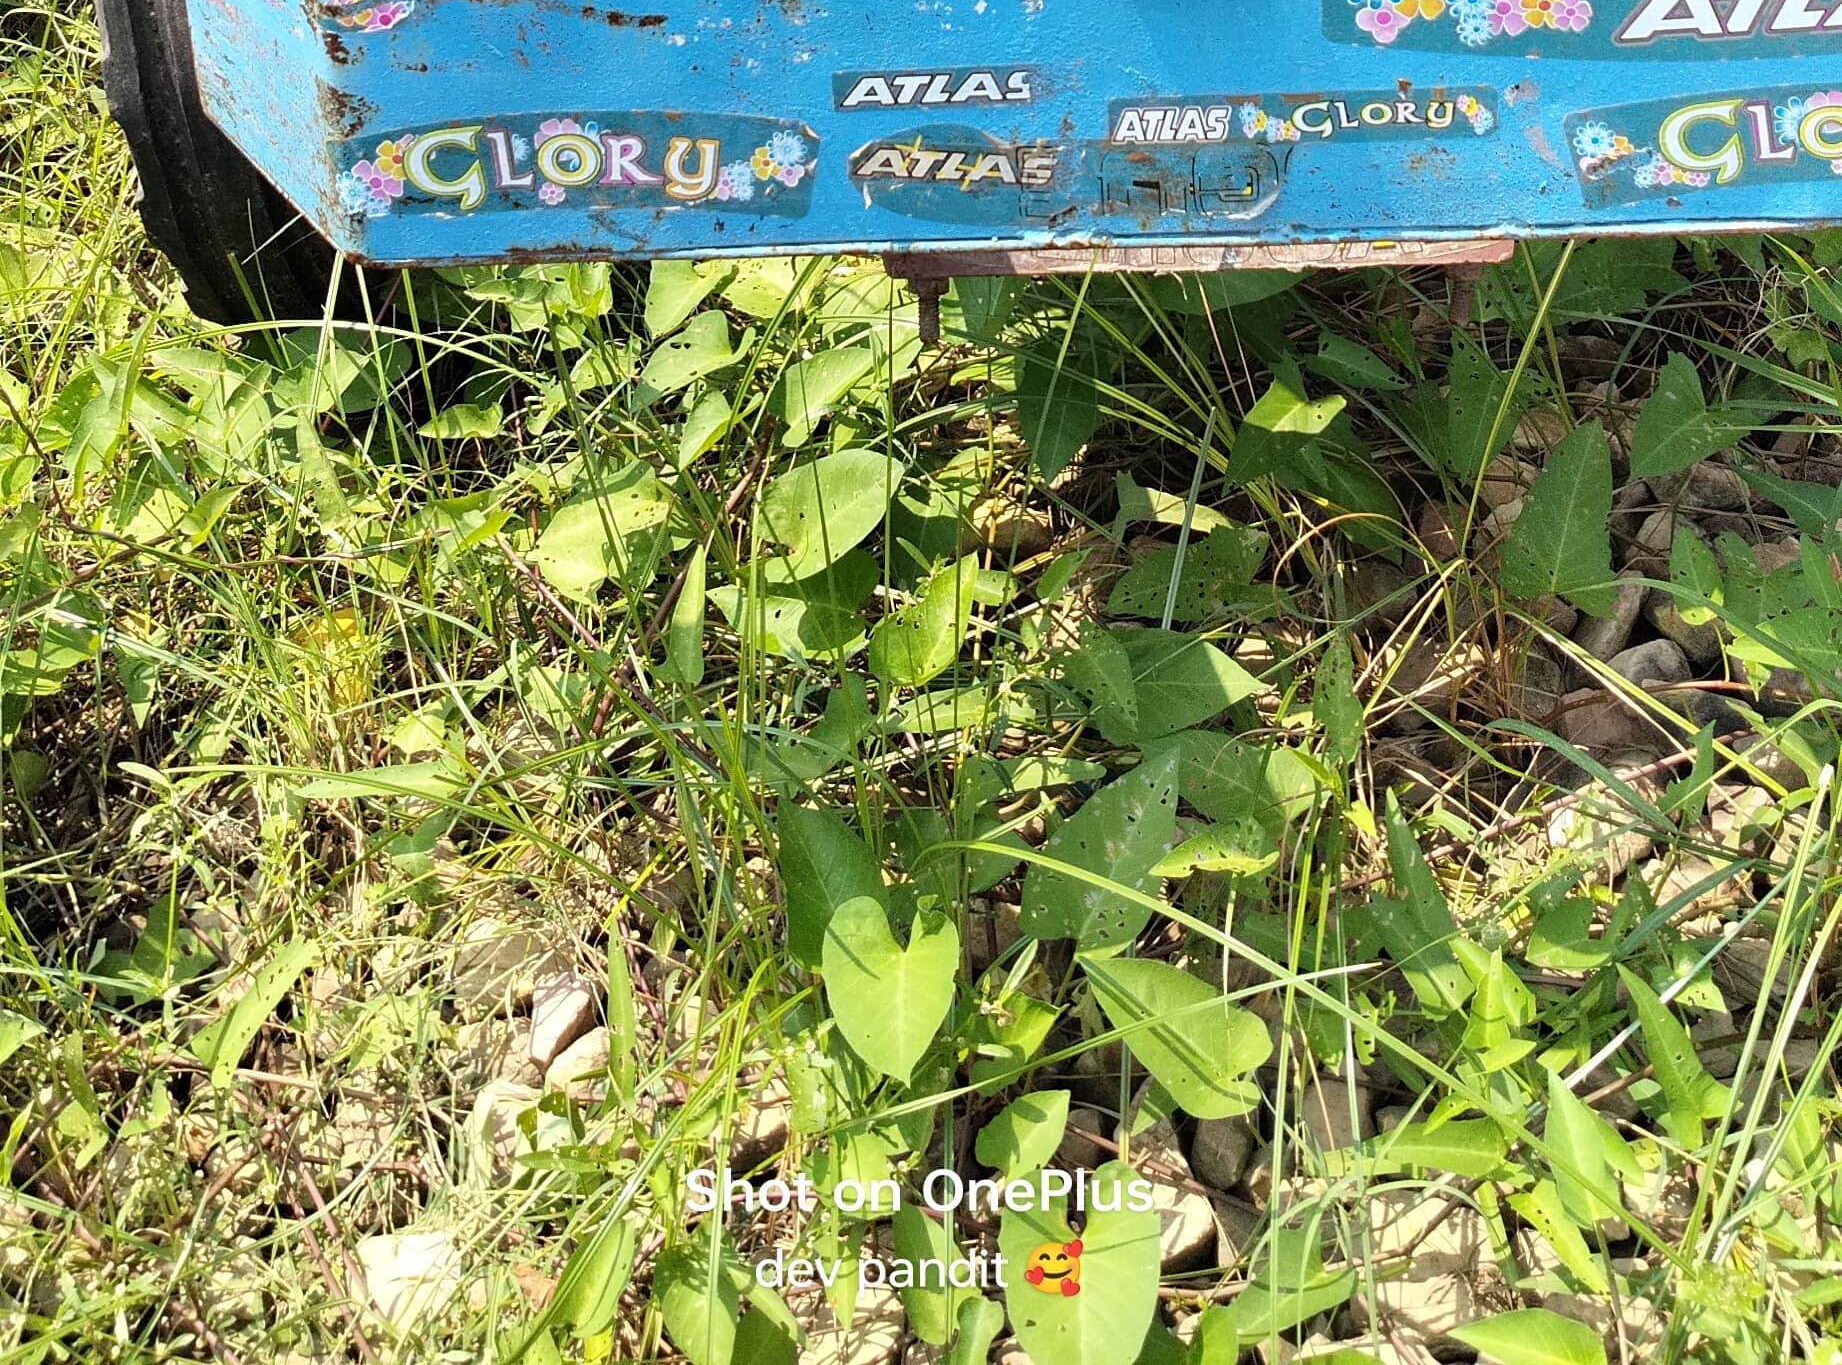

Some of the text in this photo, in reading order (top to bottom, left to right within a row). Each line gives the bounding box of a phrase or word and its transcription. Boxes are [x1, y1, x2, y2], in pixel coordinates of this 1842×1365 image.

[840, 70, 1032, 108] ATLAS
[1111, 105, 1231, 145] ATLAS
[854, 146, 1058, 187] ATLAS
